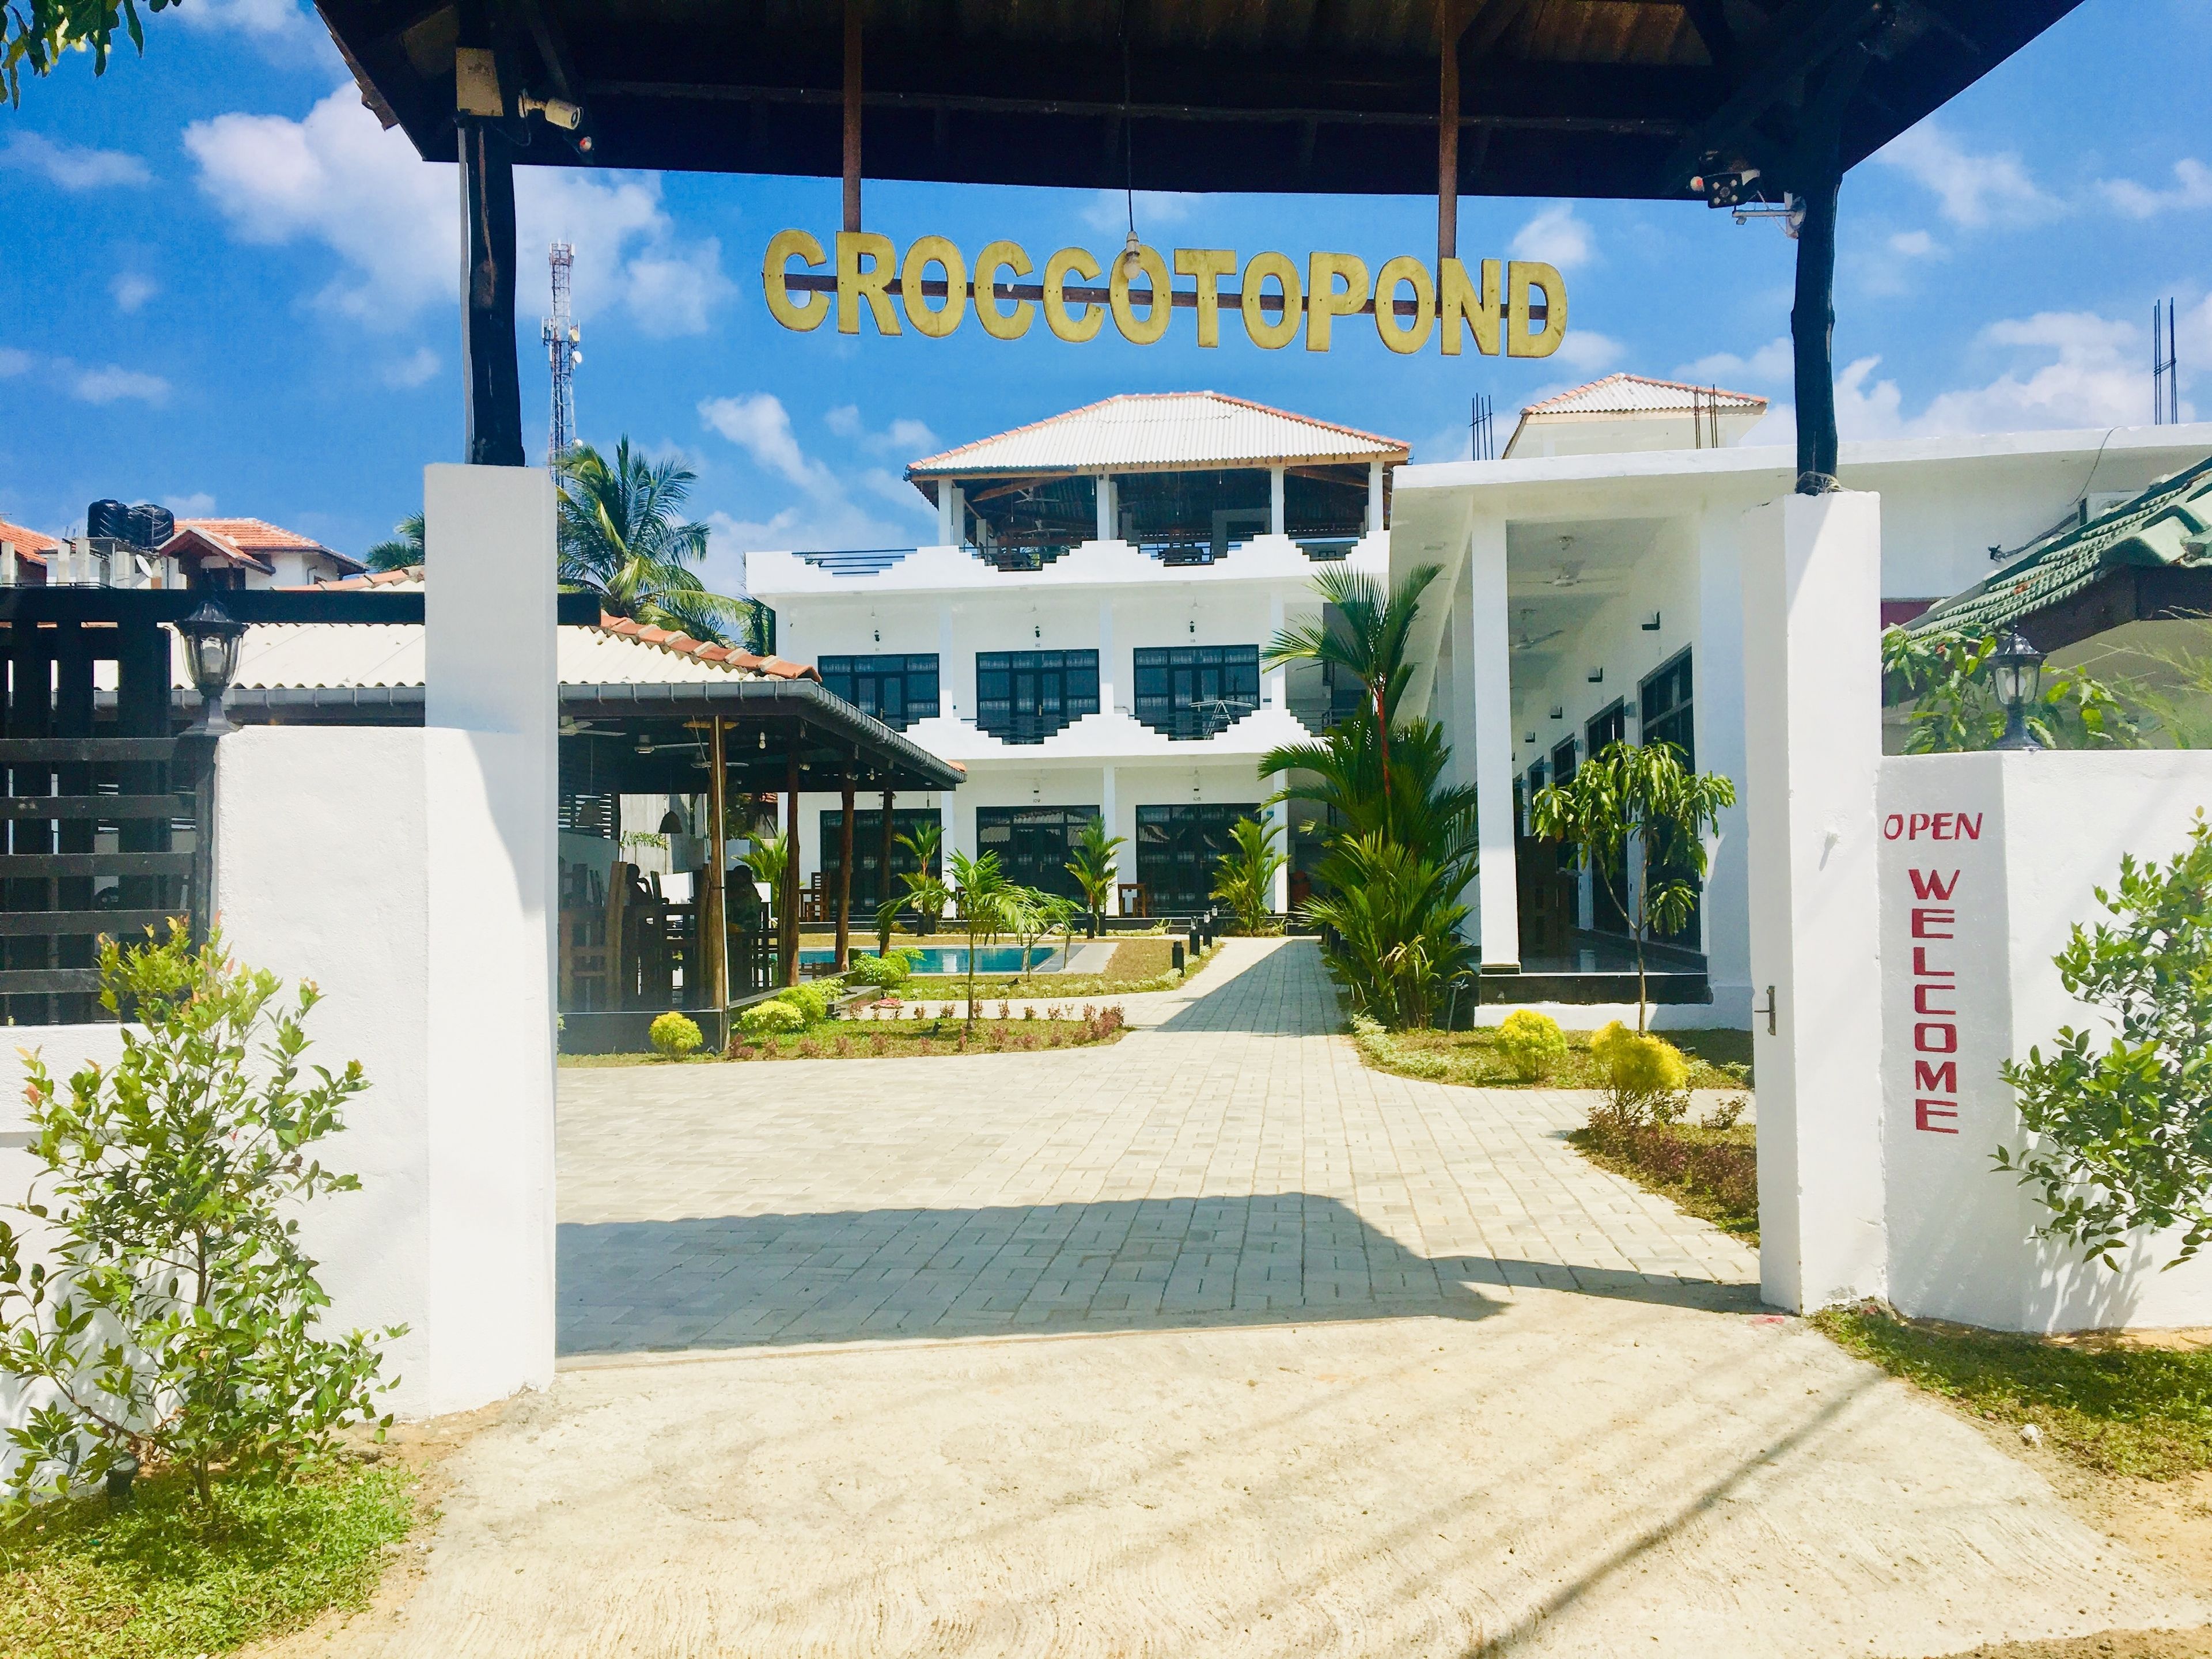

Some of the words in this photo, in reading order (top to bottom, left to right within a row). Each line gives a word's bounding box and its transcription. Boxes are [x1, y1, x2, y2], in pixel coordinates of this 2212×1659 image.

[764, 229, 1567, 358] CROCCOTOPOND
[1884, 813, 1983, 840] OPEN
[1908, 869, 1960, 1134] WELCOME
